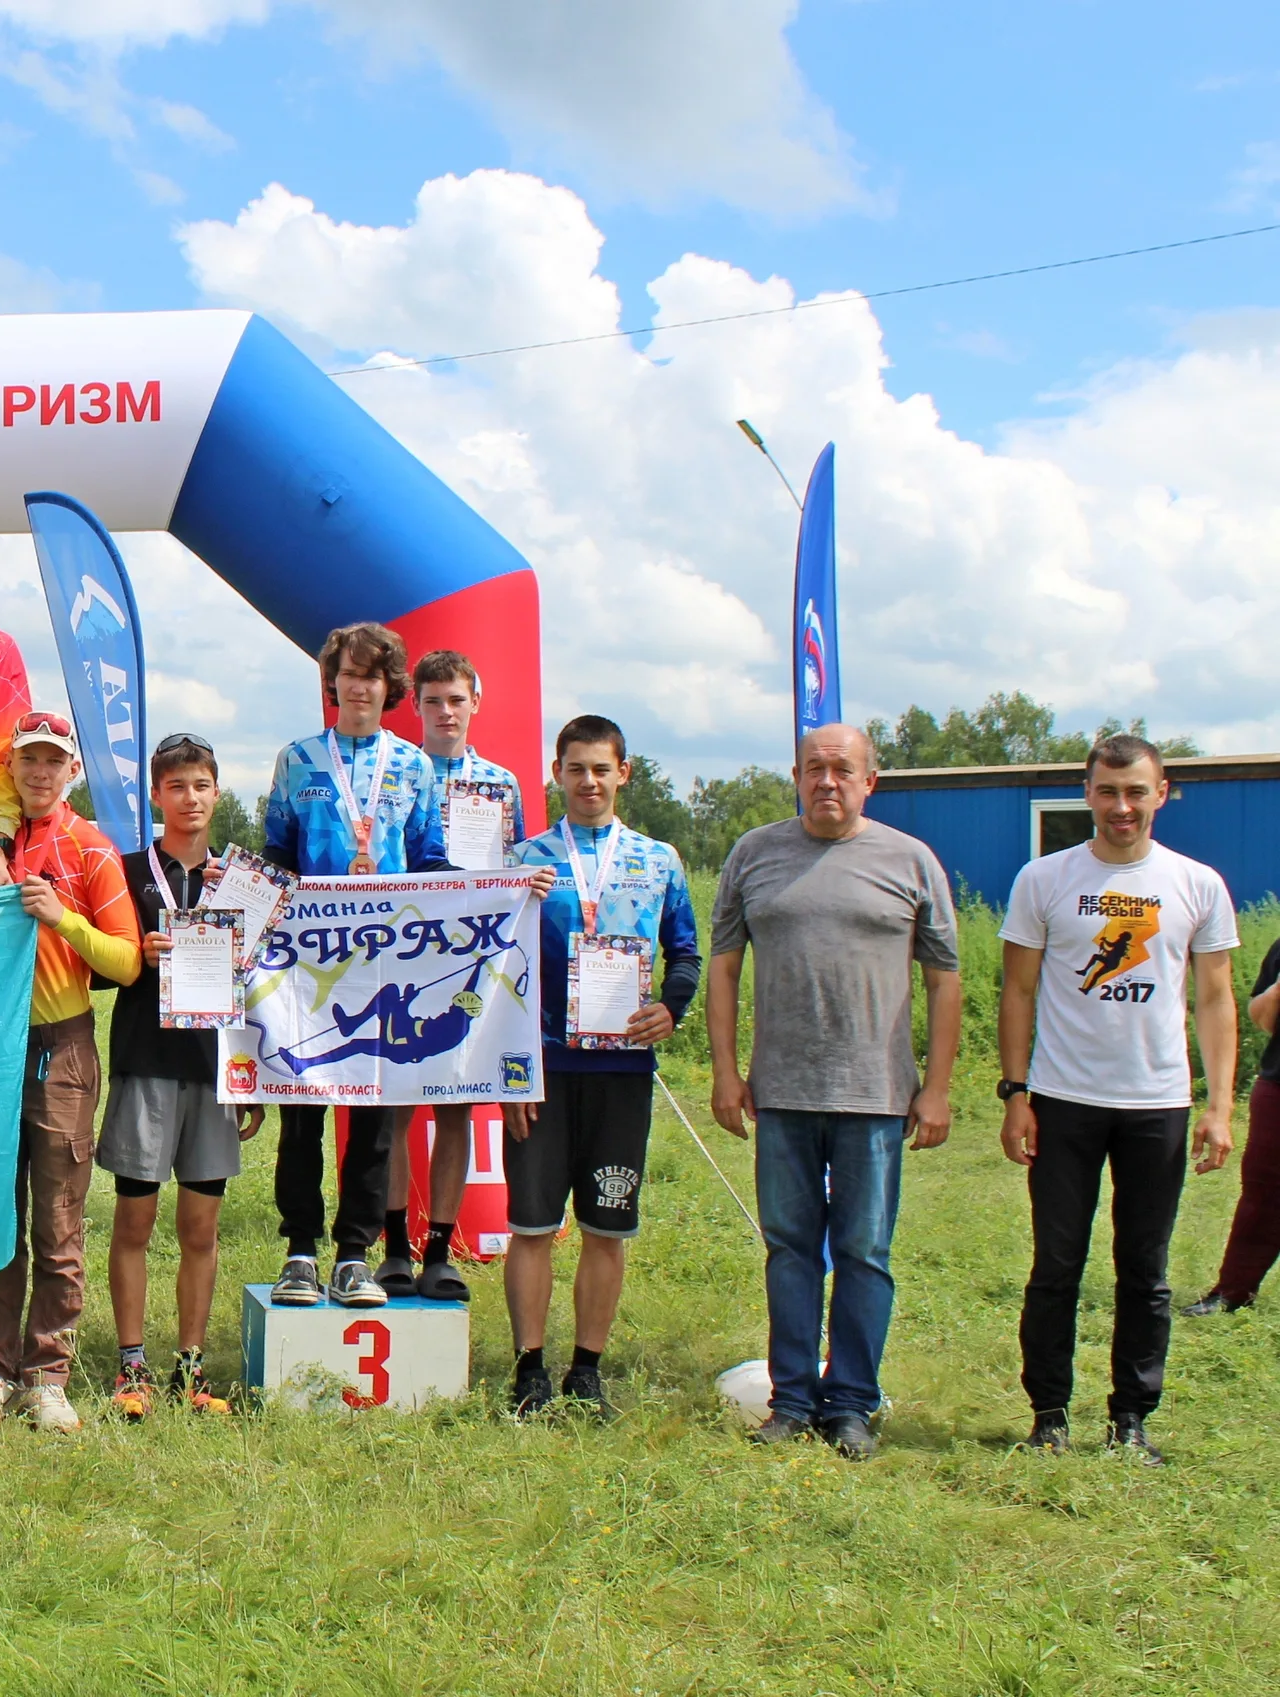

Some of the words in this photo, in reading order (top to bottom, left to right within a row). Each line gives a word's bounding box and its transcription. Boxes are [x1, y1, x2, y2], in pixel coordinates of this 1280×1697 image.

[297, 788, 332, 799] МИАСС
[377, 798, 402, 808] ИРАЖ
[455, 805, 497, 818] ГРАМОТА
[229, 874, 272, 902] ГРАМОТА
[296, 882, 332, 891] ШКОЛА
[335, 881, 419, 892] ОЛИМПИЙСКОГО
[422, 881, 466, 891] РЕЗЕРВА
[621, 882, 650, 890] ВИРАЖ
[284, 894, 394, 920] оманда
[1078, 894, 1162, 908] ВЕСЕННИЙ
[1077, 905, 1144, 918] ПРИЗЫВ
[177, 936, 226, 946] ГРАМОТА
[258, 912, 517, 970] ВИРАЖ
[585, 959, 633, 971] ГРАМОТА
[1099, 982, 1156, 1003] 2017
[261, 1083, 335, 1096] ЧЕЛЯБИНСКАЯ
[338, 1084, 383, 1096] ОБЛАСТЬ
[422, 1085, 454, 1096] ГОРОД
[456, 1082, 493, 1094] МИАСС
[593, 1165, 639, 1186] ATHLETIC
[596, 1195, 631, 1210] DEPT.
[341, 1320, 391, 1410] 3
